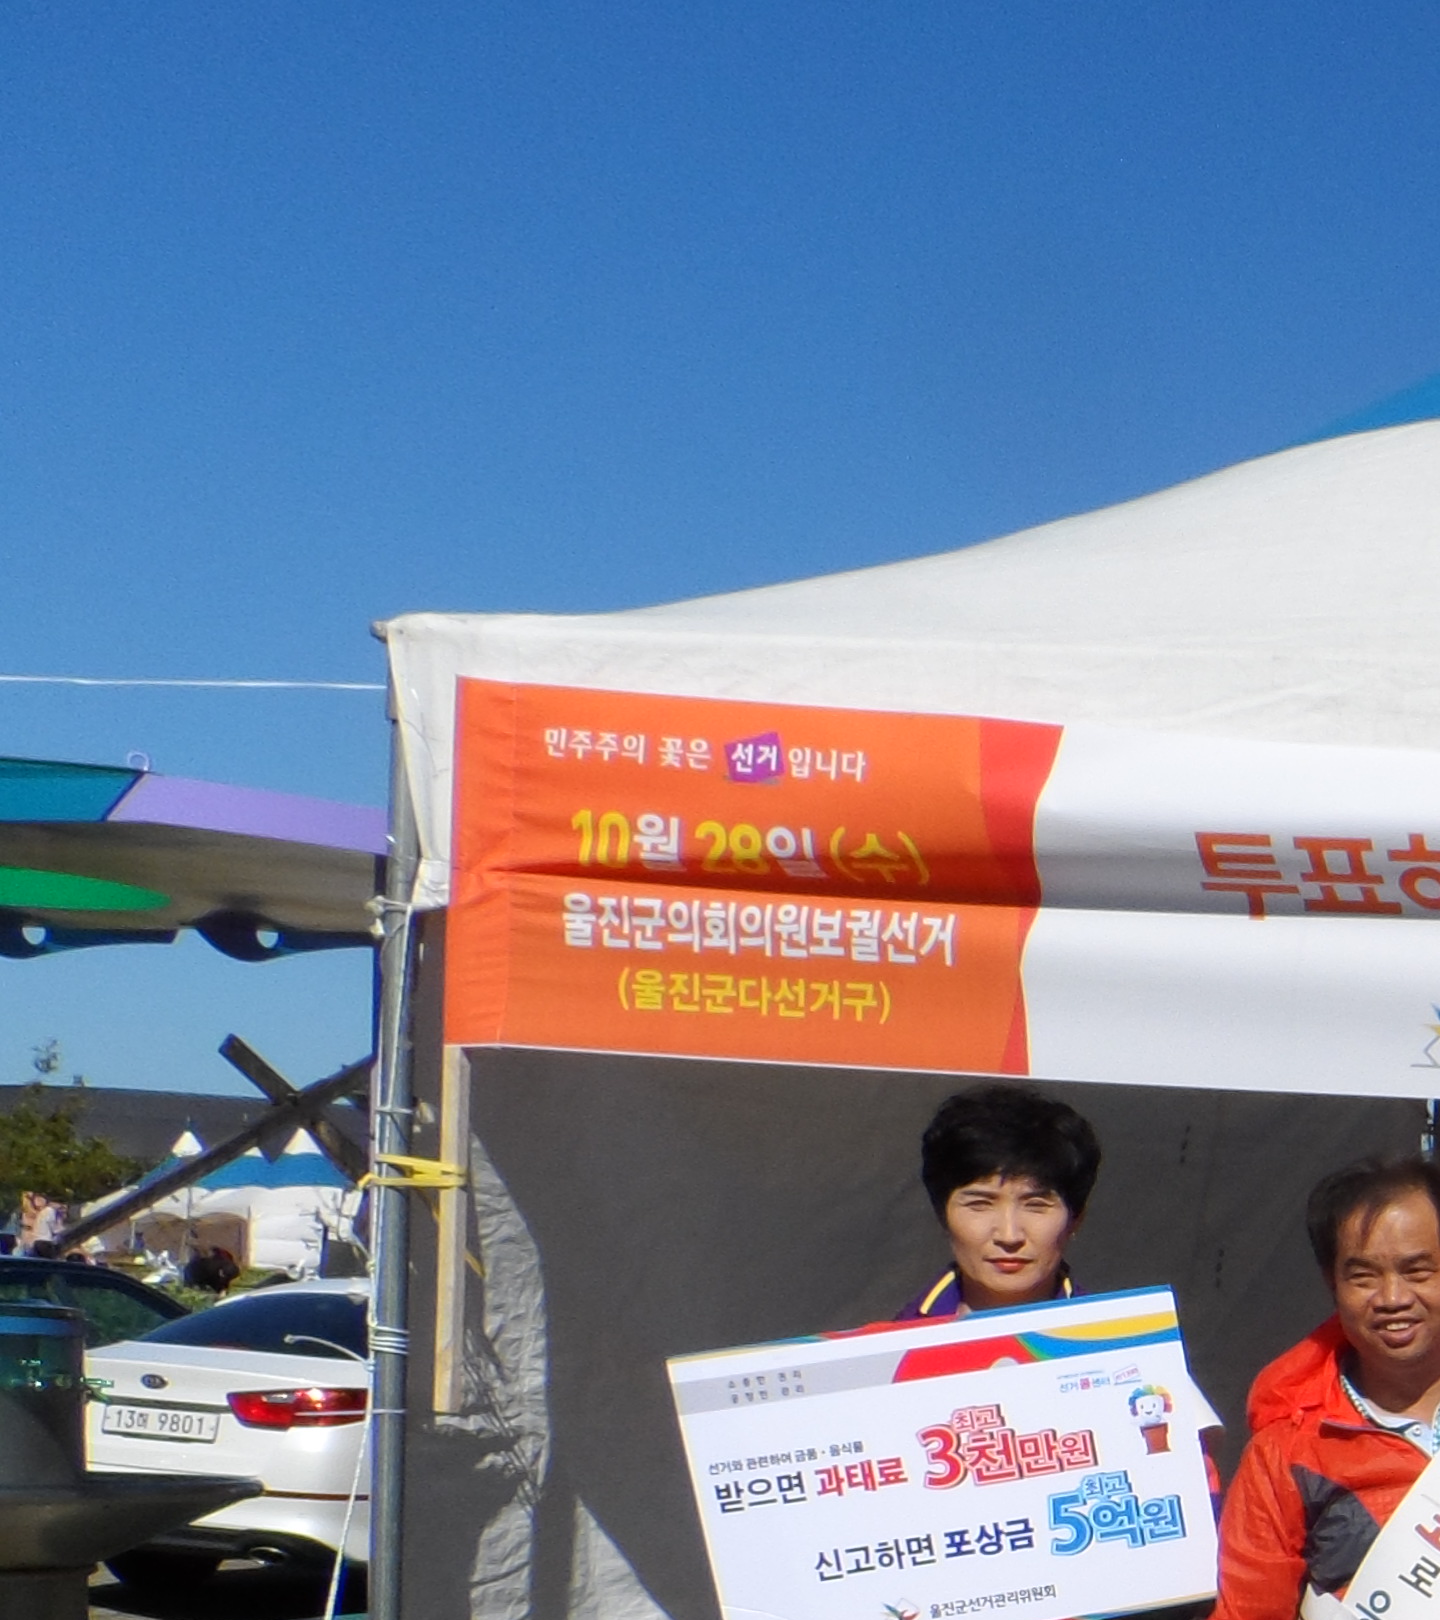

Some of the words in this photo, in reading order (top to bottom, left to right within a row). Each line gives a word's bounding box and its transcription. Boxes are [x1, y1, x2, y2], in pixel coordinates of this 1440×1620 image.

[544, 727, 646, 765] 민주주의
[658, 737, 711, 769] 꽃은
[729, 741, 779, 774] 선거
[787, 746, 866, 782] 입니다
[570, 808, 686, 871] 10월
[561, 891, 957, 966] 울진군의회의원보궐선거
[617, 967, 892, 1026] (울진군다선거구)
[158, 1412, 205, 1436] 9801
[952, 1405, 1004, 1434] 최고
[707, 1458, 745, 1477] 선거와
[714, 1474, 808, 1515] 받으면
[814, 1455, 910, 1500] 과태료
[917, 1422, 1104, 1491] 3천만원
[1083, 1471, 1131, 1500] 최고
[814, 1534, 939, 1583] 신고하면
[943, 1518, 1036, 1561] 포상금
[1048, 1488, 1188, 1556] 5억원
[928, 1582, 1058, 1620] 울진군선거관리위원회
